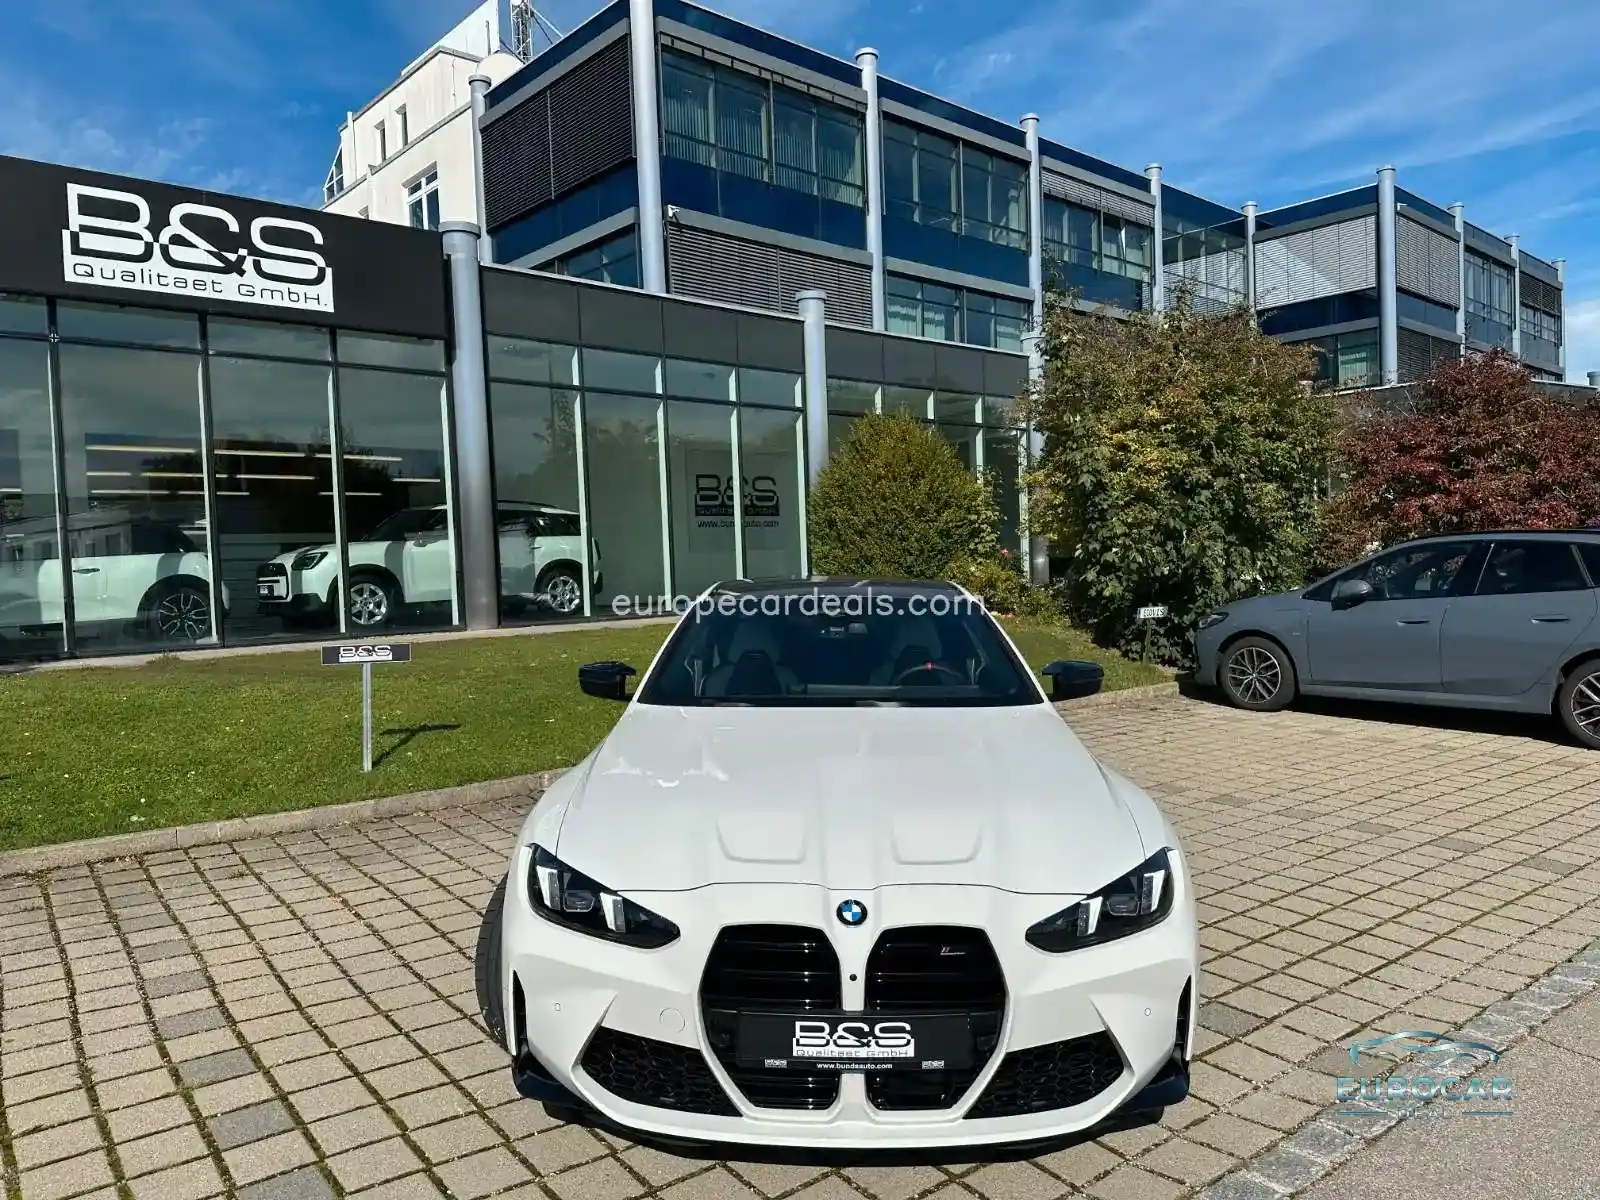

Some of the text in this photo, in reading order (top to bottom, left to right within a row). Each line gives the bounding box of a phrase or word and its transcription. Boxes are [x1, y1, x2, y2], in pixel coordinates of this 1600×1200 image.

[66, 182, 326, 286] B&S
[73, 263, 223, 293] Qualitaet
[339, 645, 392, 658] B&S
[795, 1021, 911, 1048] B&S
